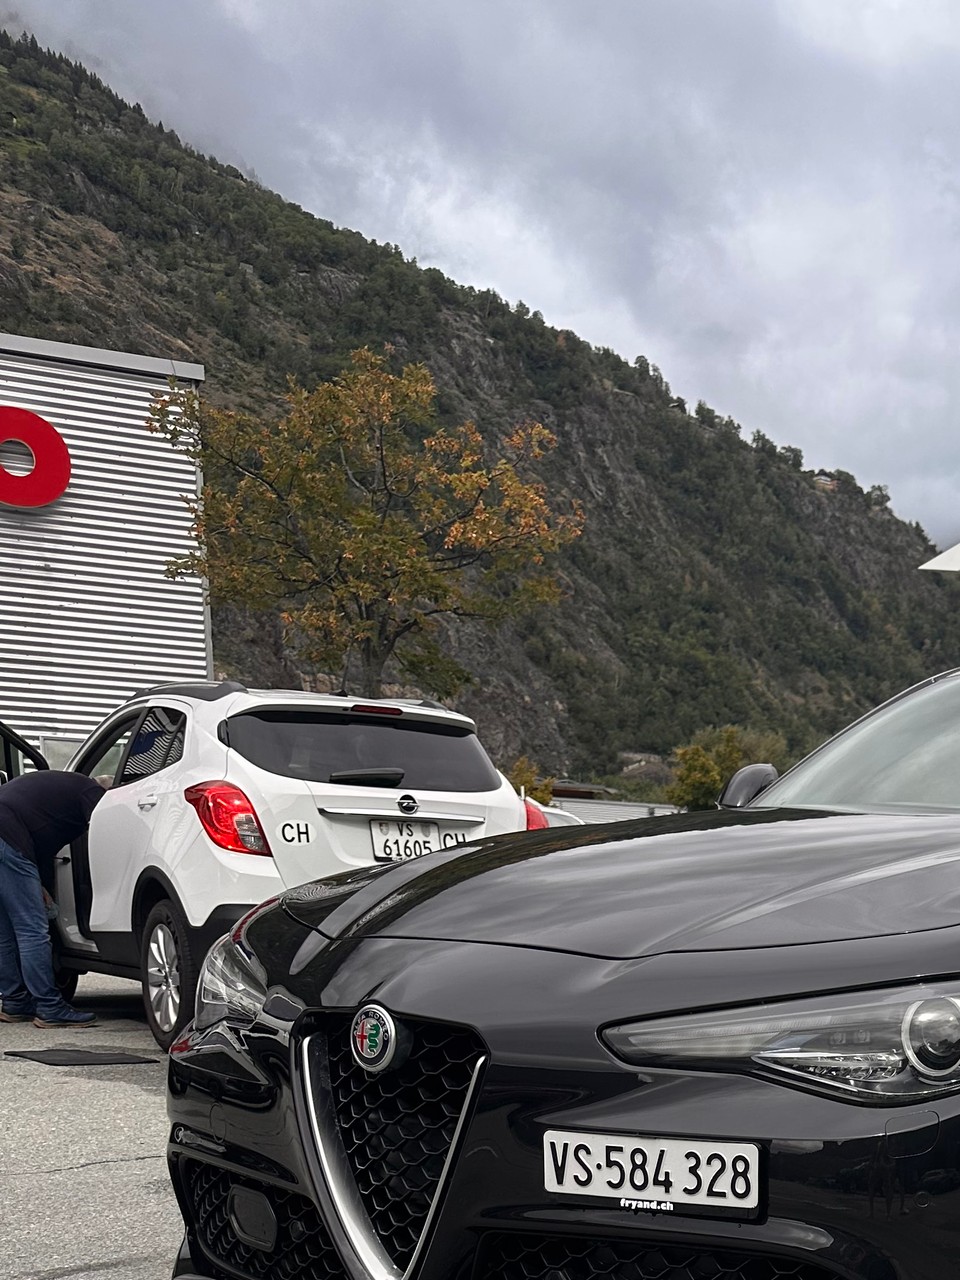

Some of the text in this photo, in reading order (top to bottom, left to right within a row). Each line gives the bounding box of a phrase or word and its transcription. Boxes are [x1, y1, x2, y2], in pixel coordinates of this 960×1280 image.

[281, 823, 310, 843] CH
[397, 823, 414, 837] VS
[383, 838, 432, 858] 61605
[368, 1011, 389, 1041] ROMEO
[620, 1198, 674, 1211] fryand.ch
